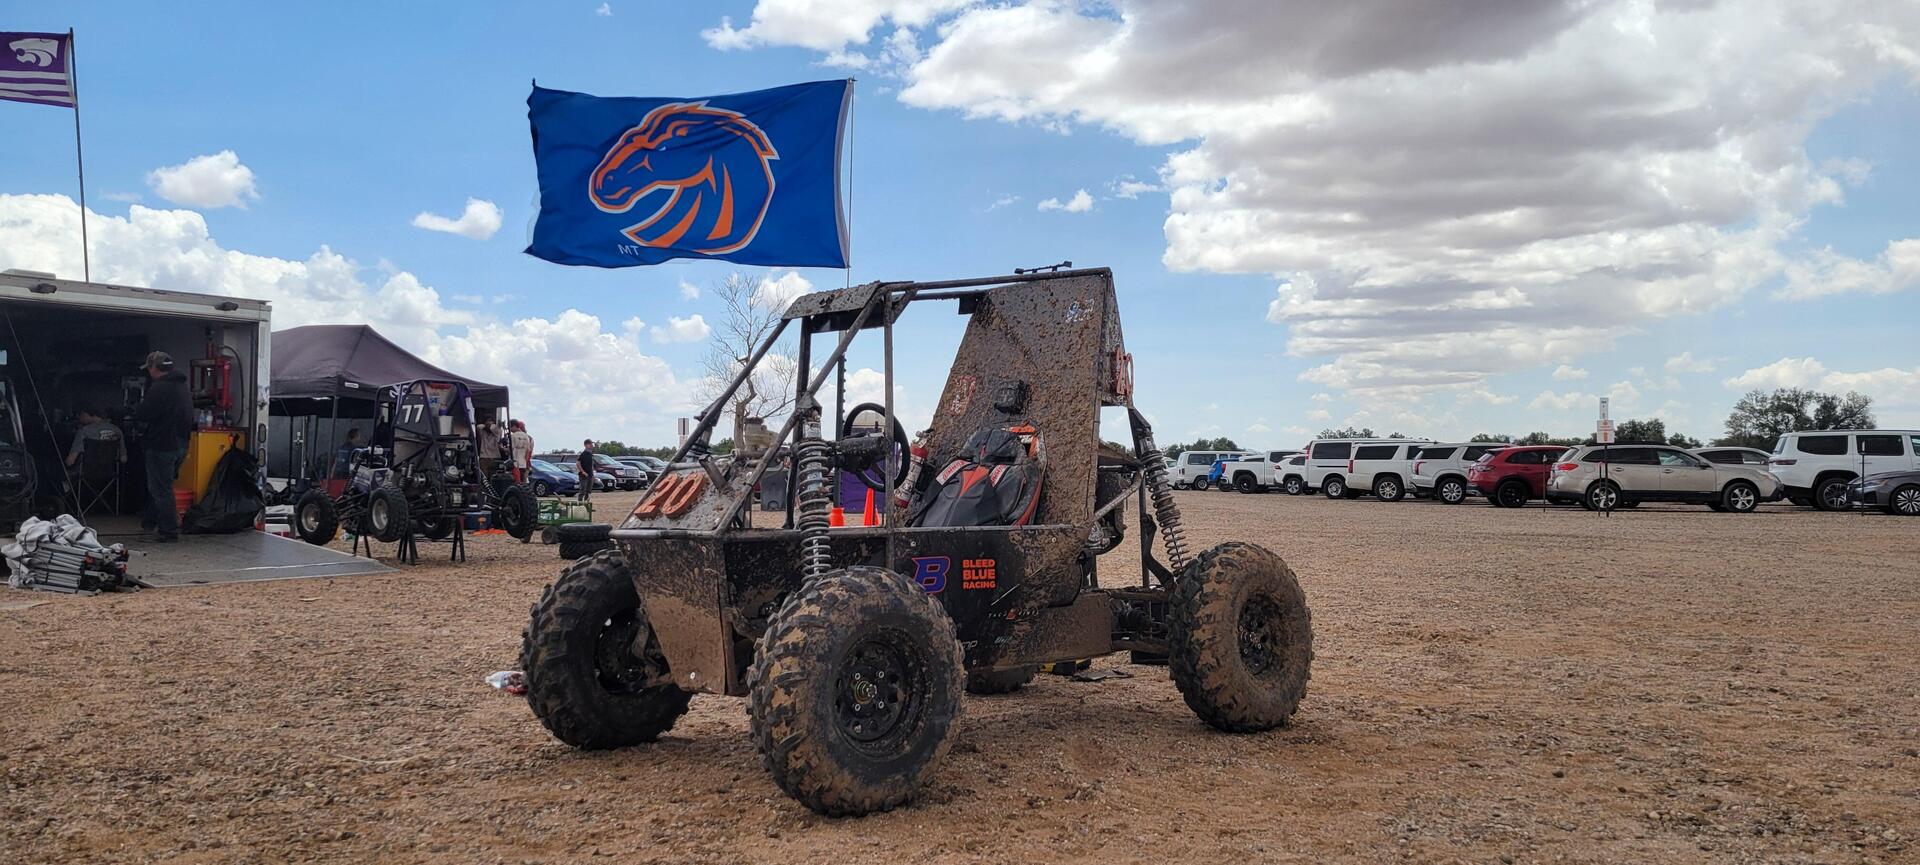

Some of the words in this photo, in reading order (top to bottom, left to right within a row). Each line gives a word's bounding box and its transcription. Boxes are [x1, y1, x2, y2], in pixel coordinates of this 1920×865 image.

[402, 404, 424, 424] 77
[634, 472, 705, 519] 20
[962, 559, 996, 568] BLEED
[911, 555, 951, 595] B
[962, 569, 996, 580] BLUE
[962, 580, 996, 590] RACING
